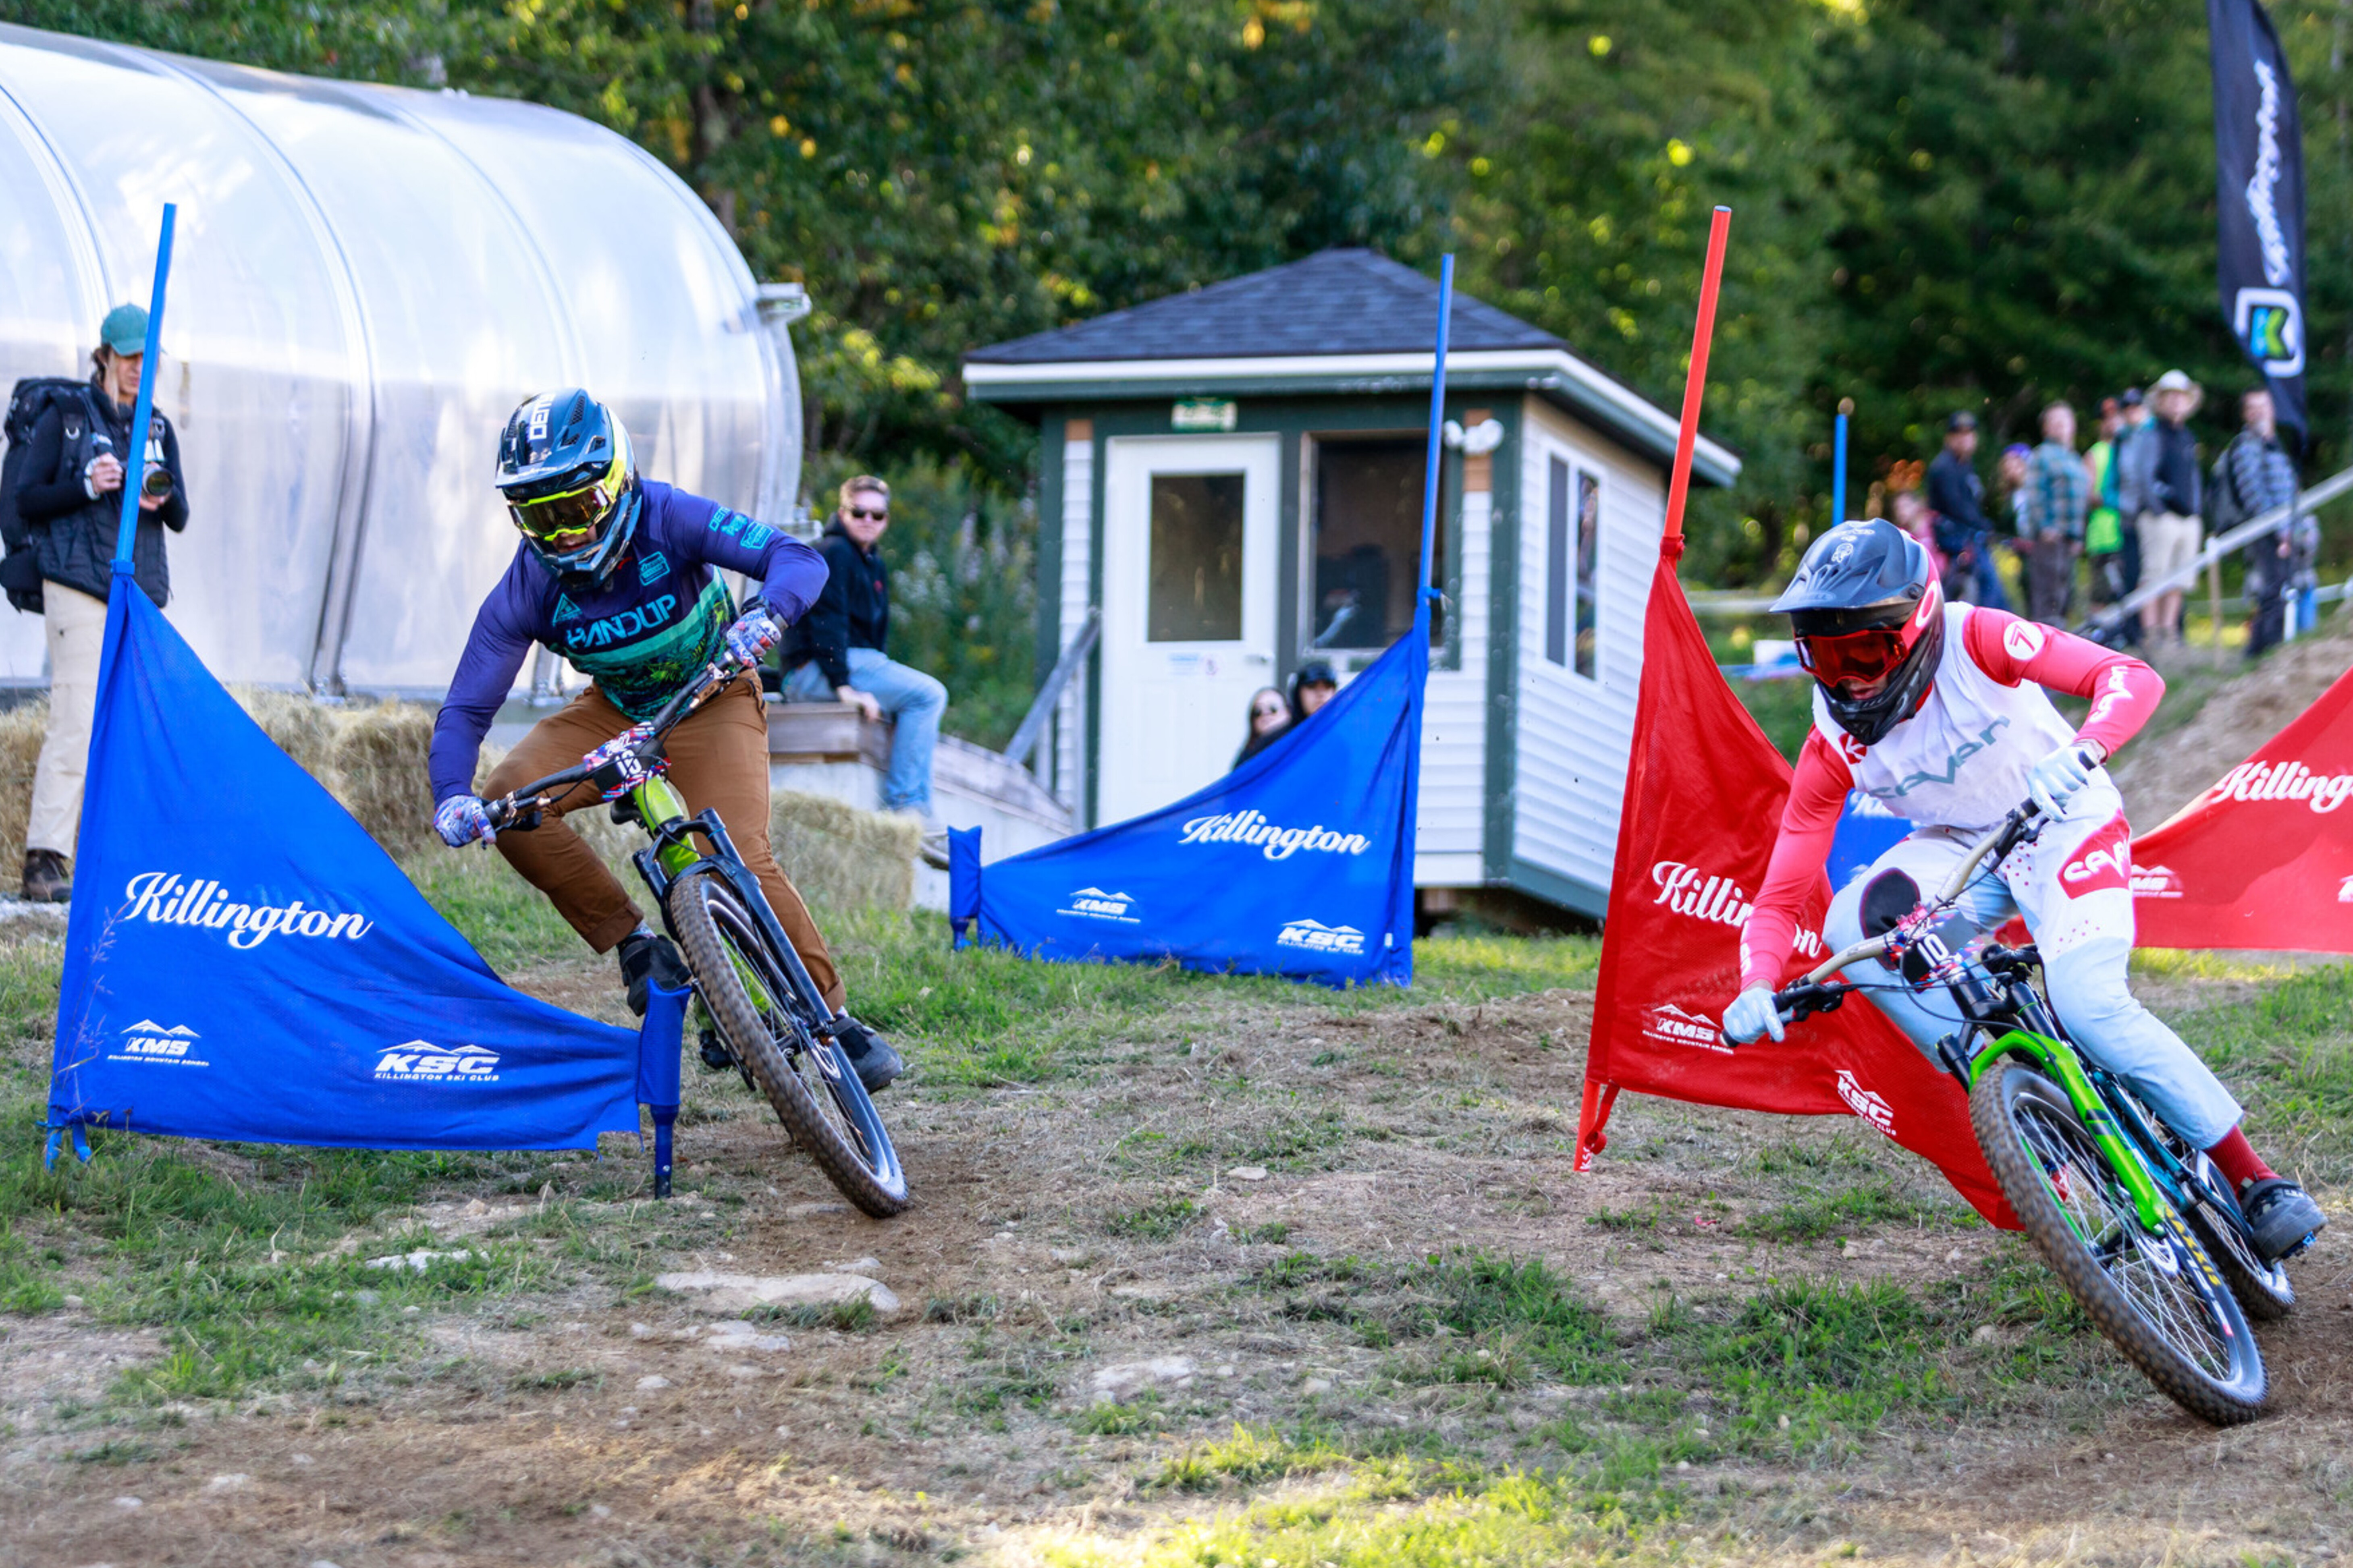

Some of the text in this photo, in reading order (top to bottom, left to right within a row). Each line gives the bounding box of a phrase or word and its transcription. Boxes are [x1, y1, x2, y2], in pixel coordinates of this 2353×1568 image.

[566, 594, 677, 649] HANDUP
[2211, 760, 2353, 813] Killing
[1178, 809, 1371, 861] Killington
[125, 872, 374, 950] Killington
[1072, 898, 1128, 915] KMS
[1277, 926, 1365, 948] KSC
[1917, 933, 1950, 968] 10
[1656, 1017, 1715, 1042] KMS
[125, 1037, 191, 1056] KMS
[374, 1053, 501, 1074] KSC
[374, 1072, 443, 1081] KILLINGTON
[1837, 1074, 1894, 1127] KSC
